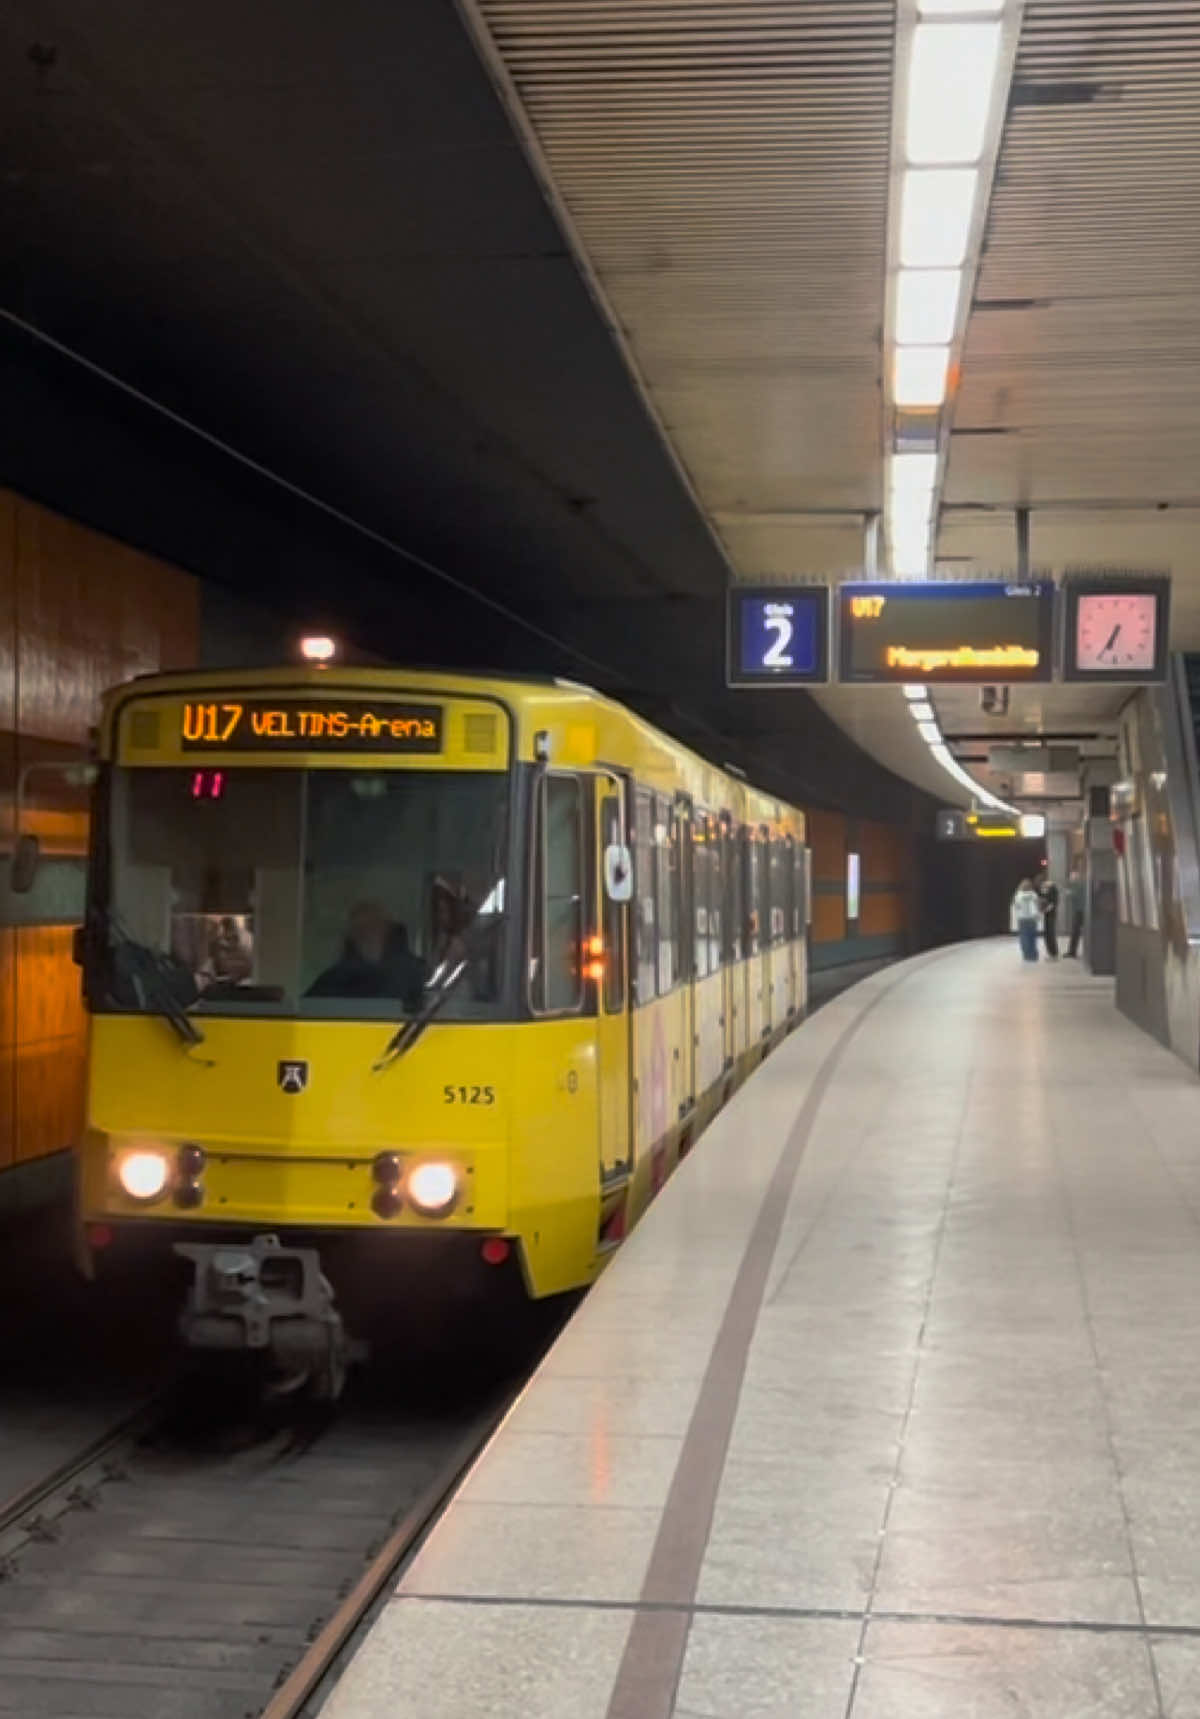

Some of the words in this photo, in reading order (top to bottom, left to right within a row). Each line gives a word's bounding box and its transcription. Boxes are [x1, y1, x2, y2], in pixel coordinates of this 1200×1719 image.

[852, 596, 885, 618] U17
[763, 618, 793, 666] 2
[183, 704, 242, 742] U17
[251, 711, 436, 738] VELTINS-Arena
[193, 773, 221, 797] 11
[443, 1085, 496, 1105] 5125
